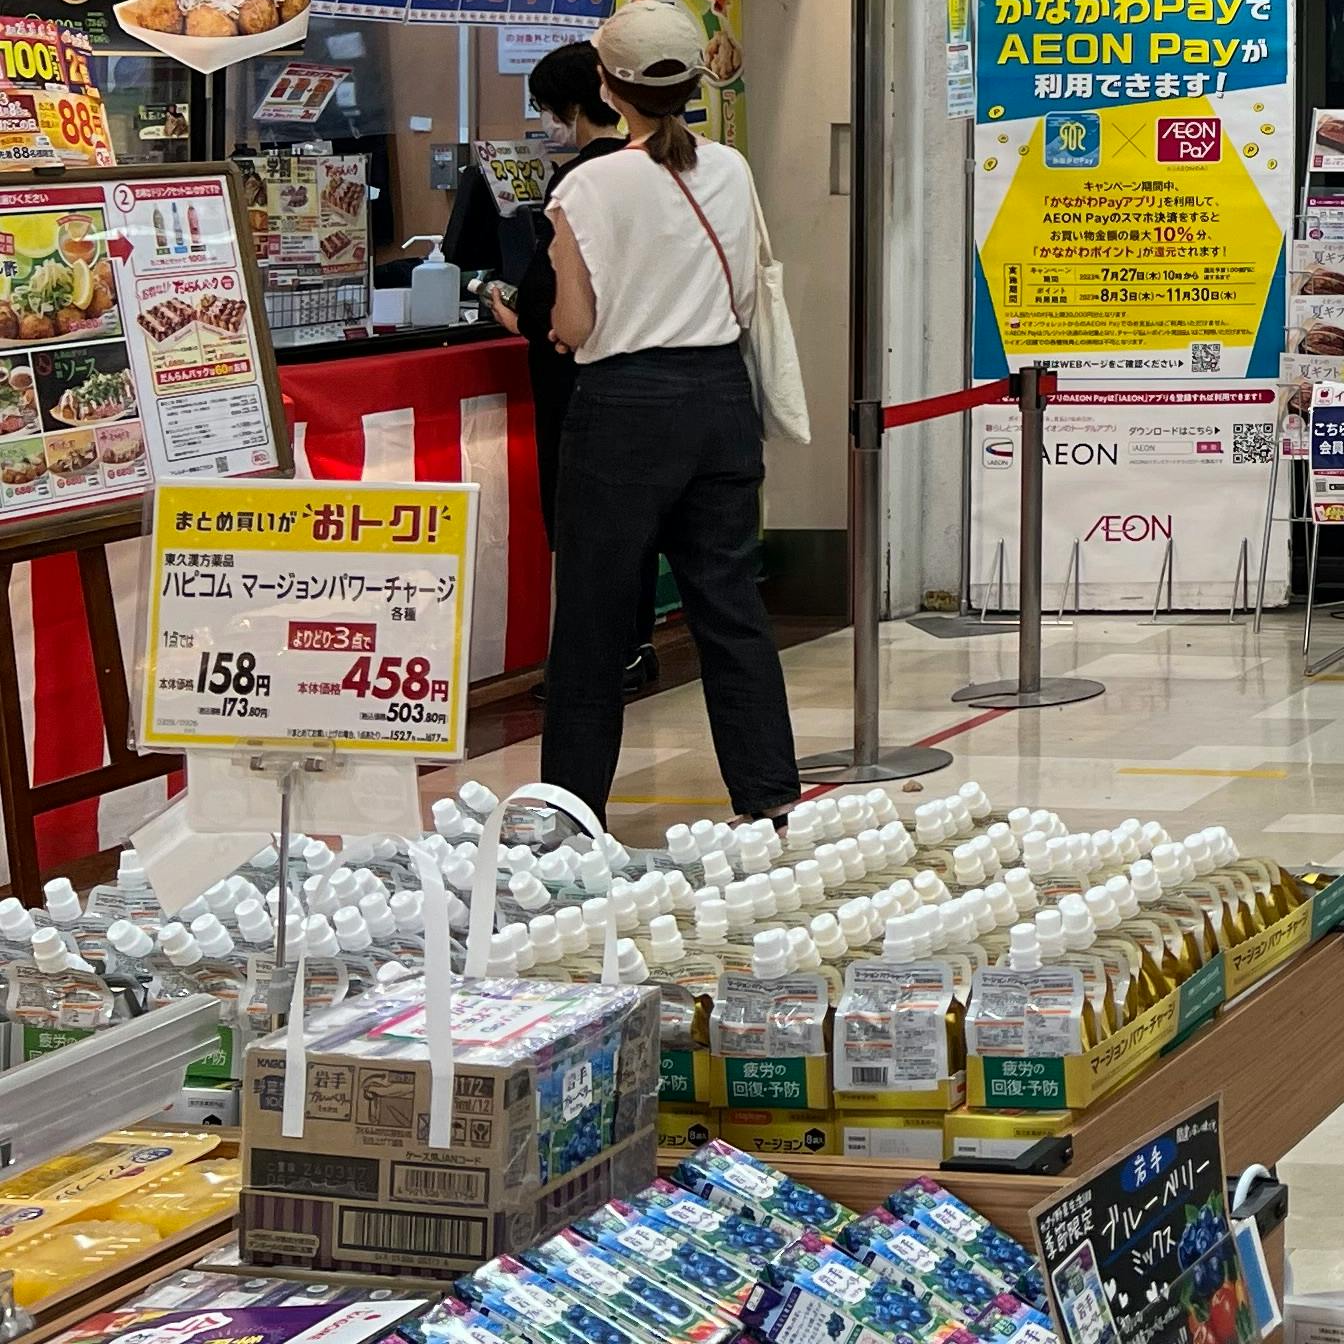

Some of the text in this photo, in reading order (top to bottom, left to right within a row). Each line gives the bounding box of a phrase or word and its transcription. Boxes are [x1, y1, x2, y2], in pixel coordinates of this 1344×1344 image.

[997, 32, 1268, 67] AEON Payが
[1034, 72, 1228, 99] 利用できます!
[1043, 213, 1082, 223] AEON
[1300, 364, 1341, 379] 夏ギフト
[1129, 426, 1214, 436] ダウンロードはこちら
[175, 504, 438, 543] まとめ買いが おトク!
[164, 553, 234, 568] 東久漢方薬品
[162, 571, 457, 604] ハピコム マージョンパワーチャージ
[391, 607, 416, 621] 各種
[292, 626, 372, 650] よりどり3点で
[257, 1057, 286, 1069] KAGO
[743, 1062, 786, 1078] 疲労の
[1002, 1060, 1045, 1076] 疲労の
[315, 1072, 347, 1090] 岩手
[754, 1137, 803, 1151] マージョン
[1133, 1145, 1163, 1188] 岩手
[1101, 1158, 1210, 1251] ブルーベリー
[1131, 1225, 1177, 1275] ミックス
